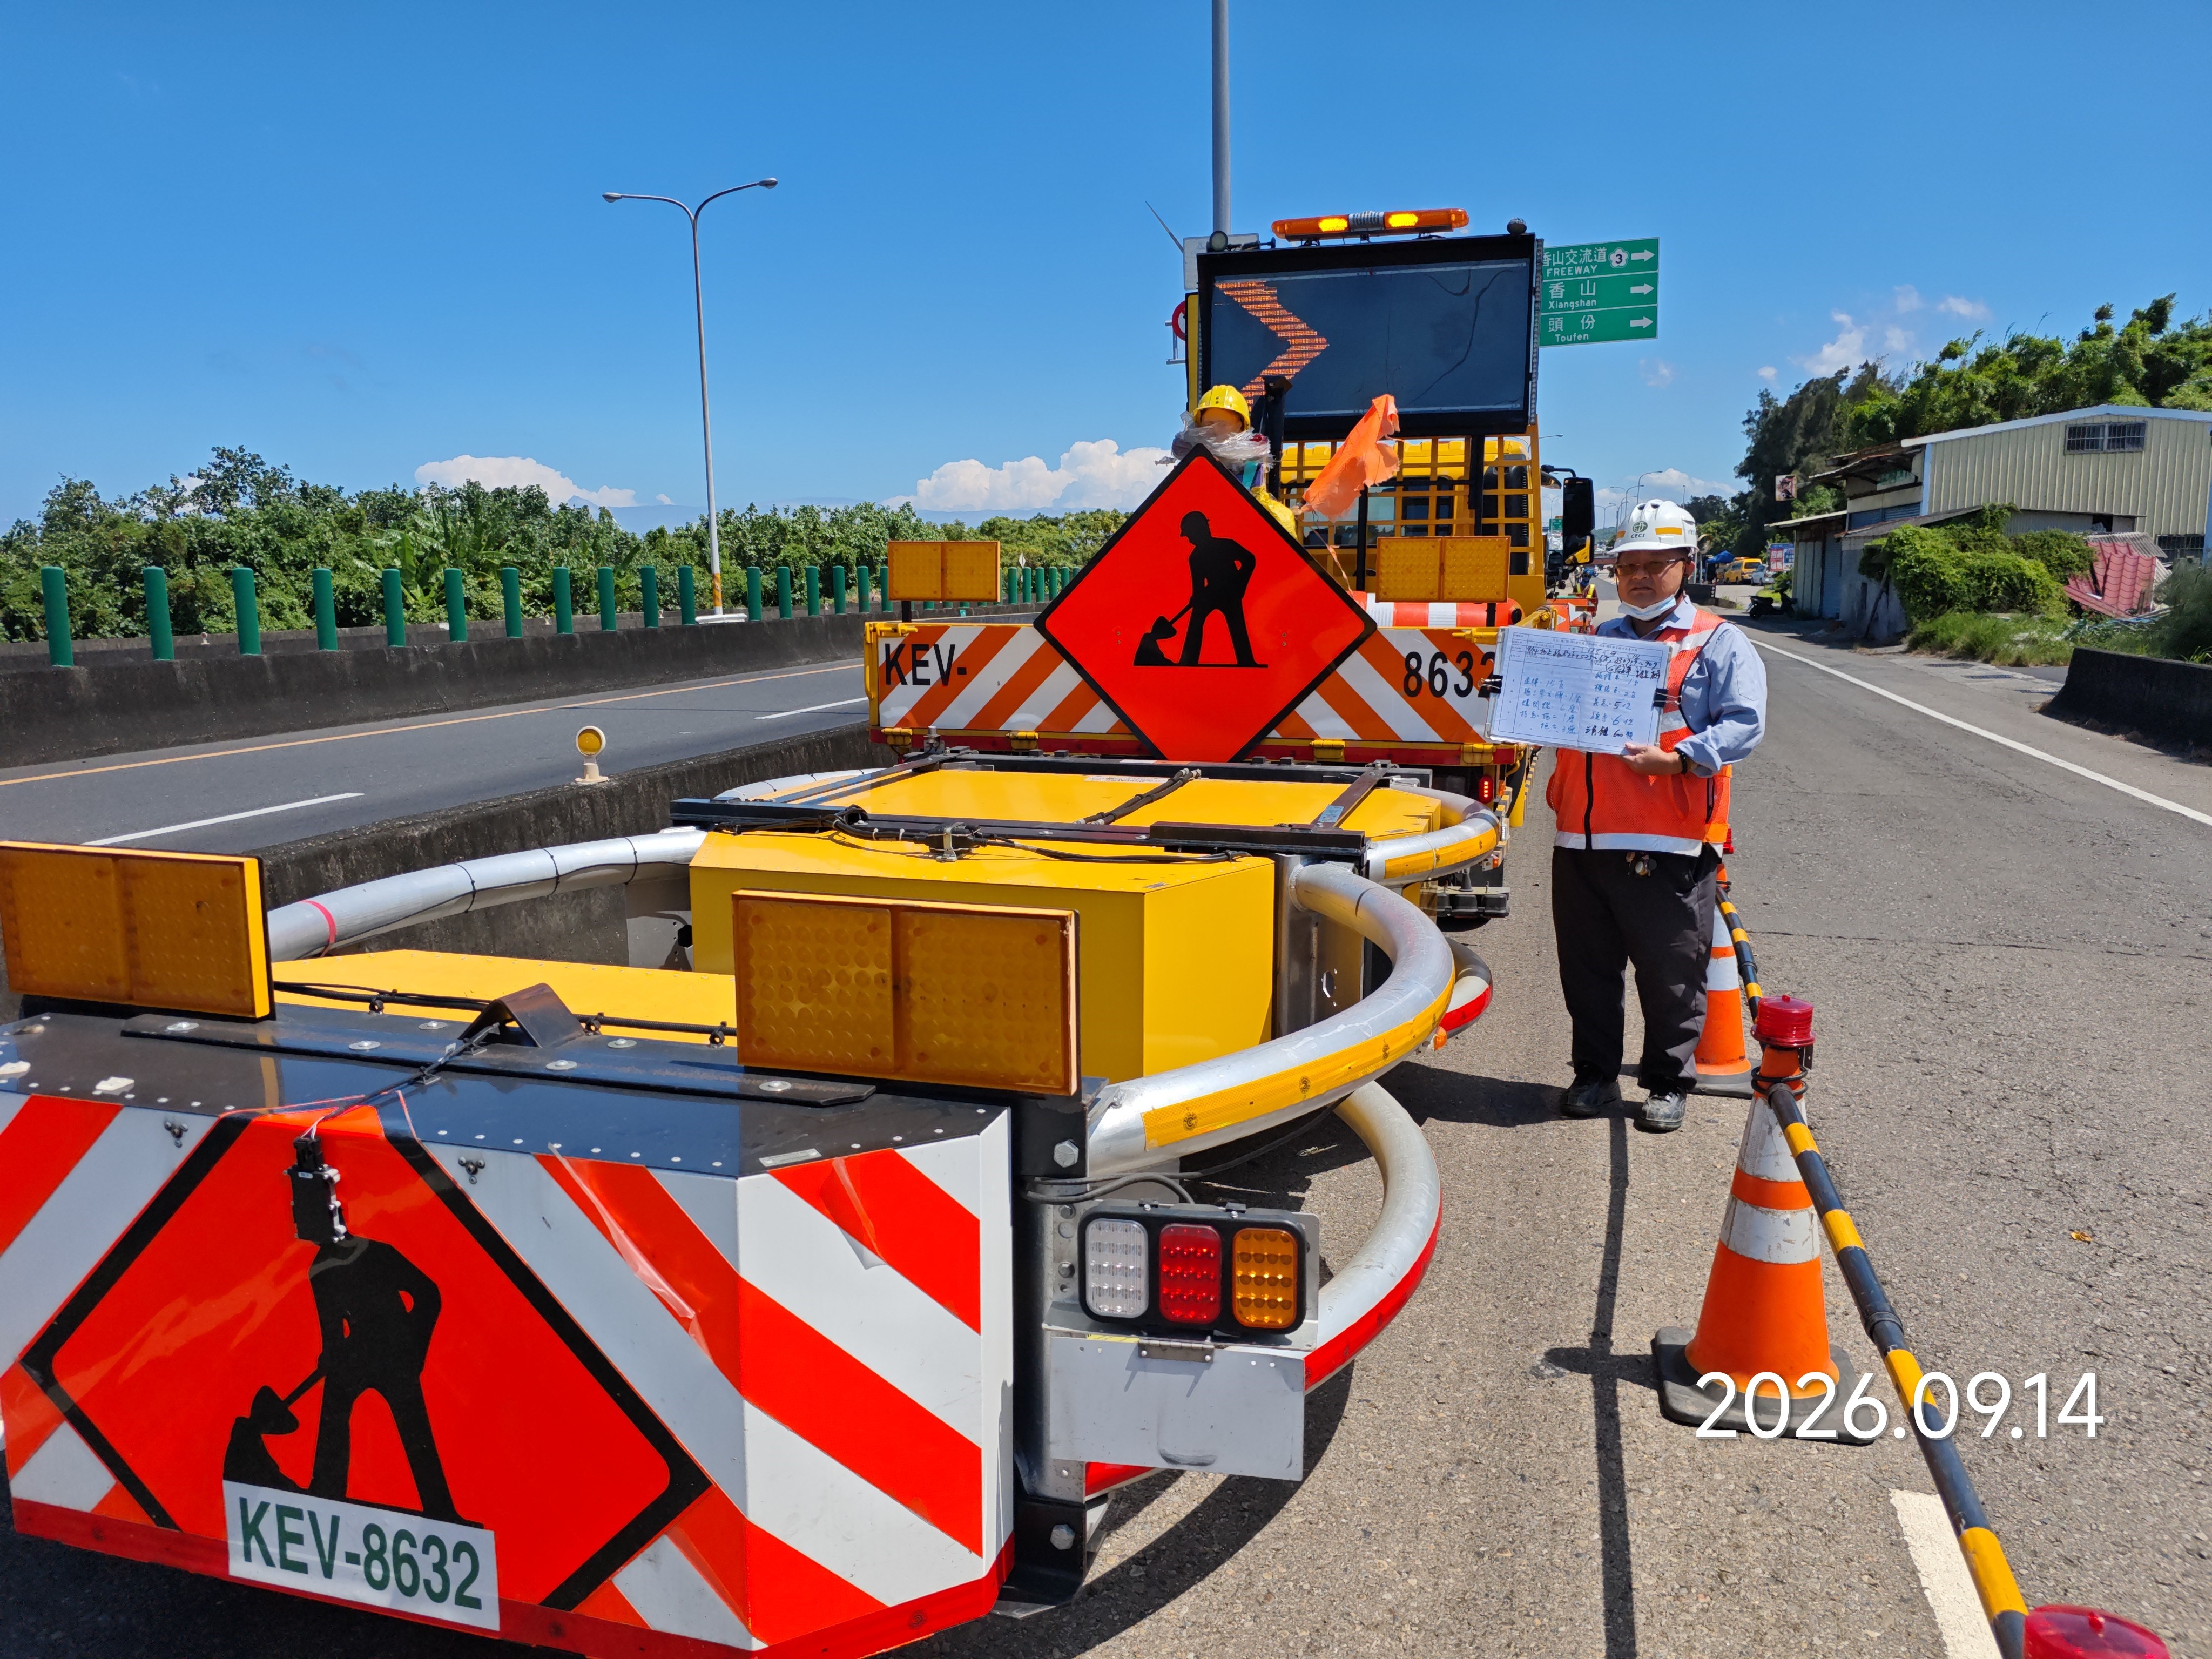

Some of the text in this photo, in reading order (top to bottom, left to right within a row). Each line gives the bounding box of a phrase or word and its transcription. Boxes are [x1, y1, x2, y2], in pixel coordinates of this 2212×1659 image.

[1542, 246, 1623, 267] 香山交流道 3
[1547, 265, 1597, 278] FREEWAY
[1549, 280, 1596, 299] 香山
[1548, 299, 1596, 311] Xiangshan
[1548, 314, 1595, 332] 頭份
[1554, 332, 1589, 342] Toufen
[885, 643, 967, 686] KEV-
[239, 1496, 482, 1610] KEV-8632
